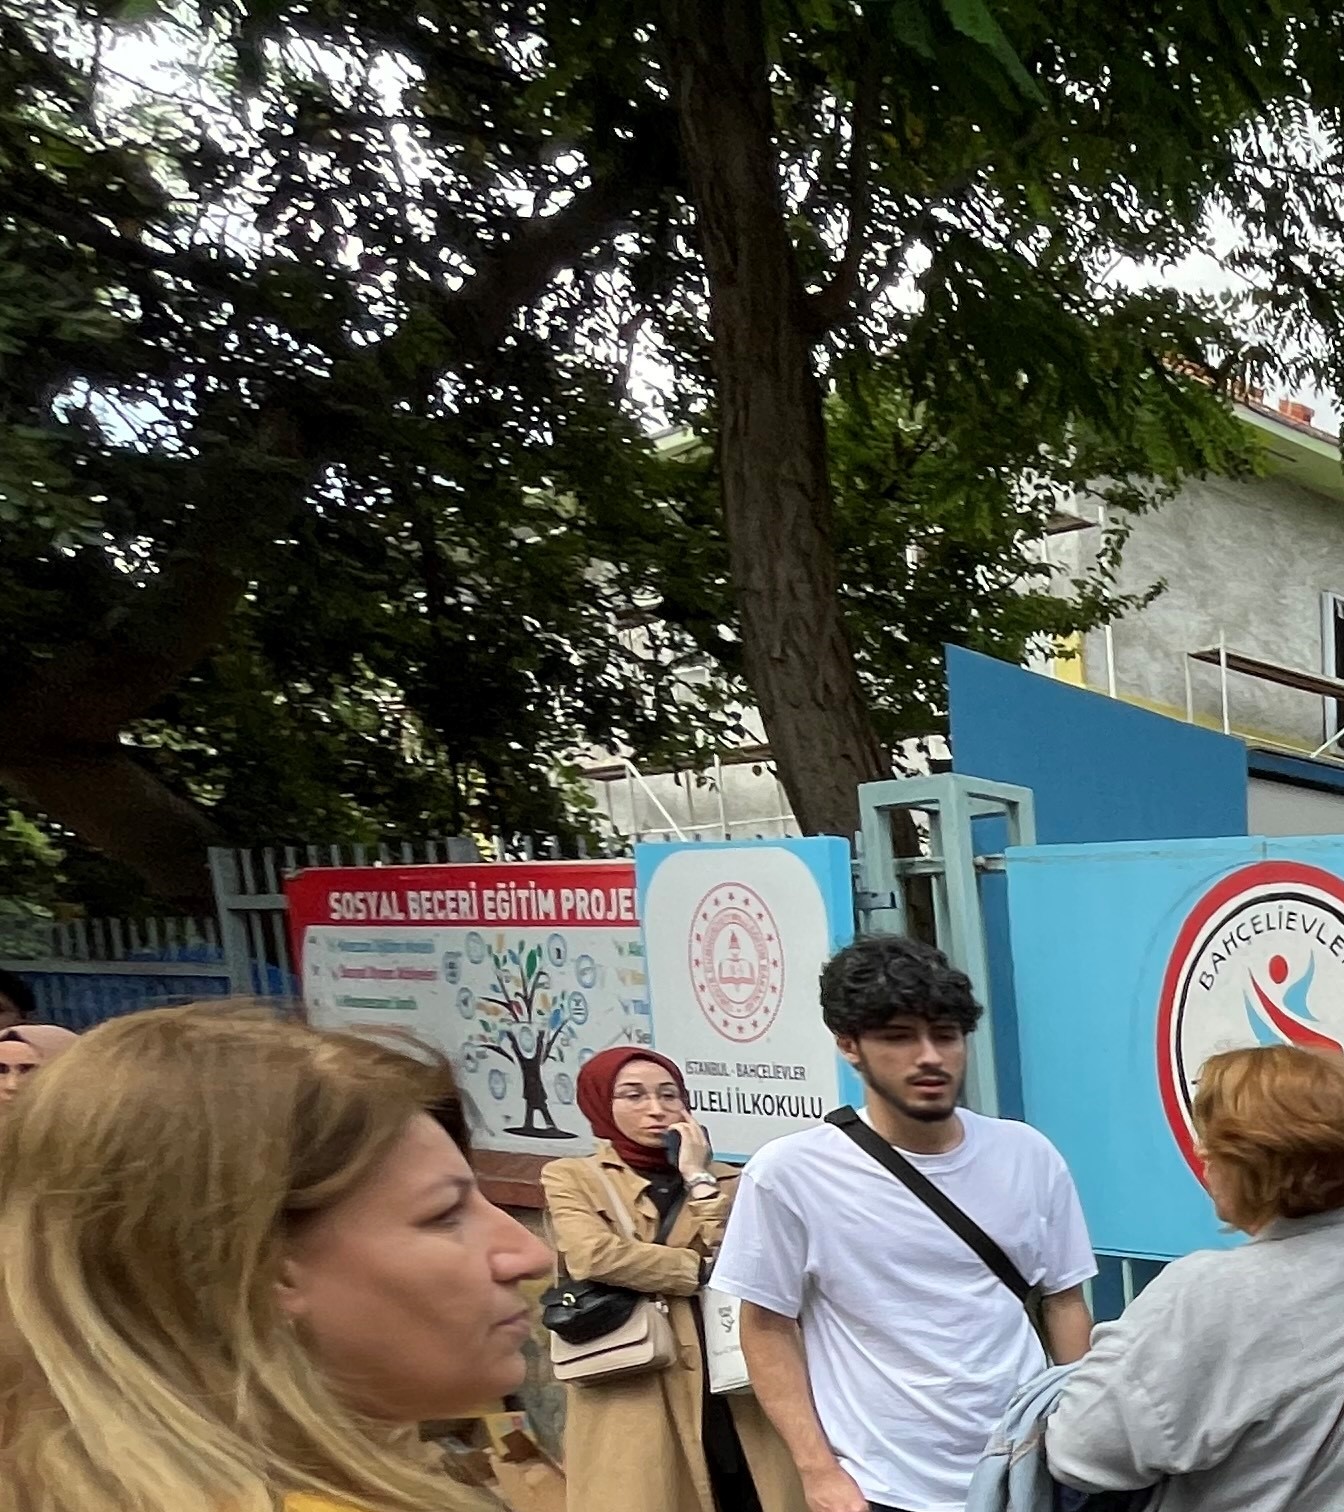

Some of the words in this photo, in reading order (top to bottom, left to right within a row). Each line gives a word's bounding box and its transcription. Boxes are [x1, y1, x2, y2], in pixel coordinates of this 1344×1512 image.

[328, 890, 406, 921] SOSYAL
[406, 881, 479, 921] BECERİ
[483, 880, 557, 921] EĞİTİM
[685, 1057, 730, 1077] İSTANBUL
[736, 1062, 807, 1083] BAHÇELİEVLER
[686, 1086, 732, 1113] ULELİ
[735, 1086, 822, 1119] İLKOKULU
